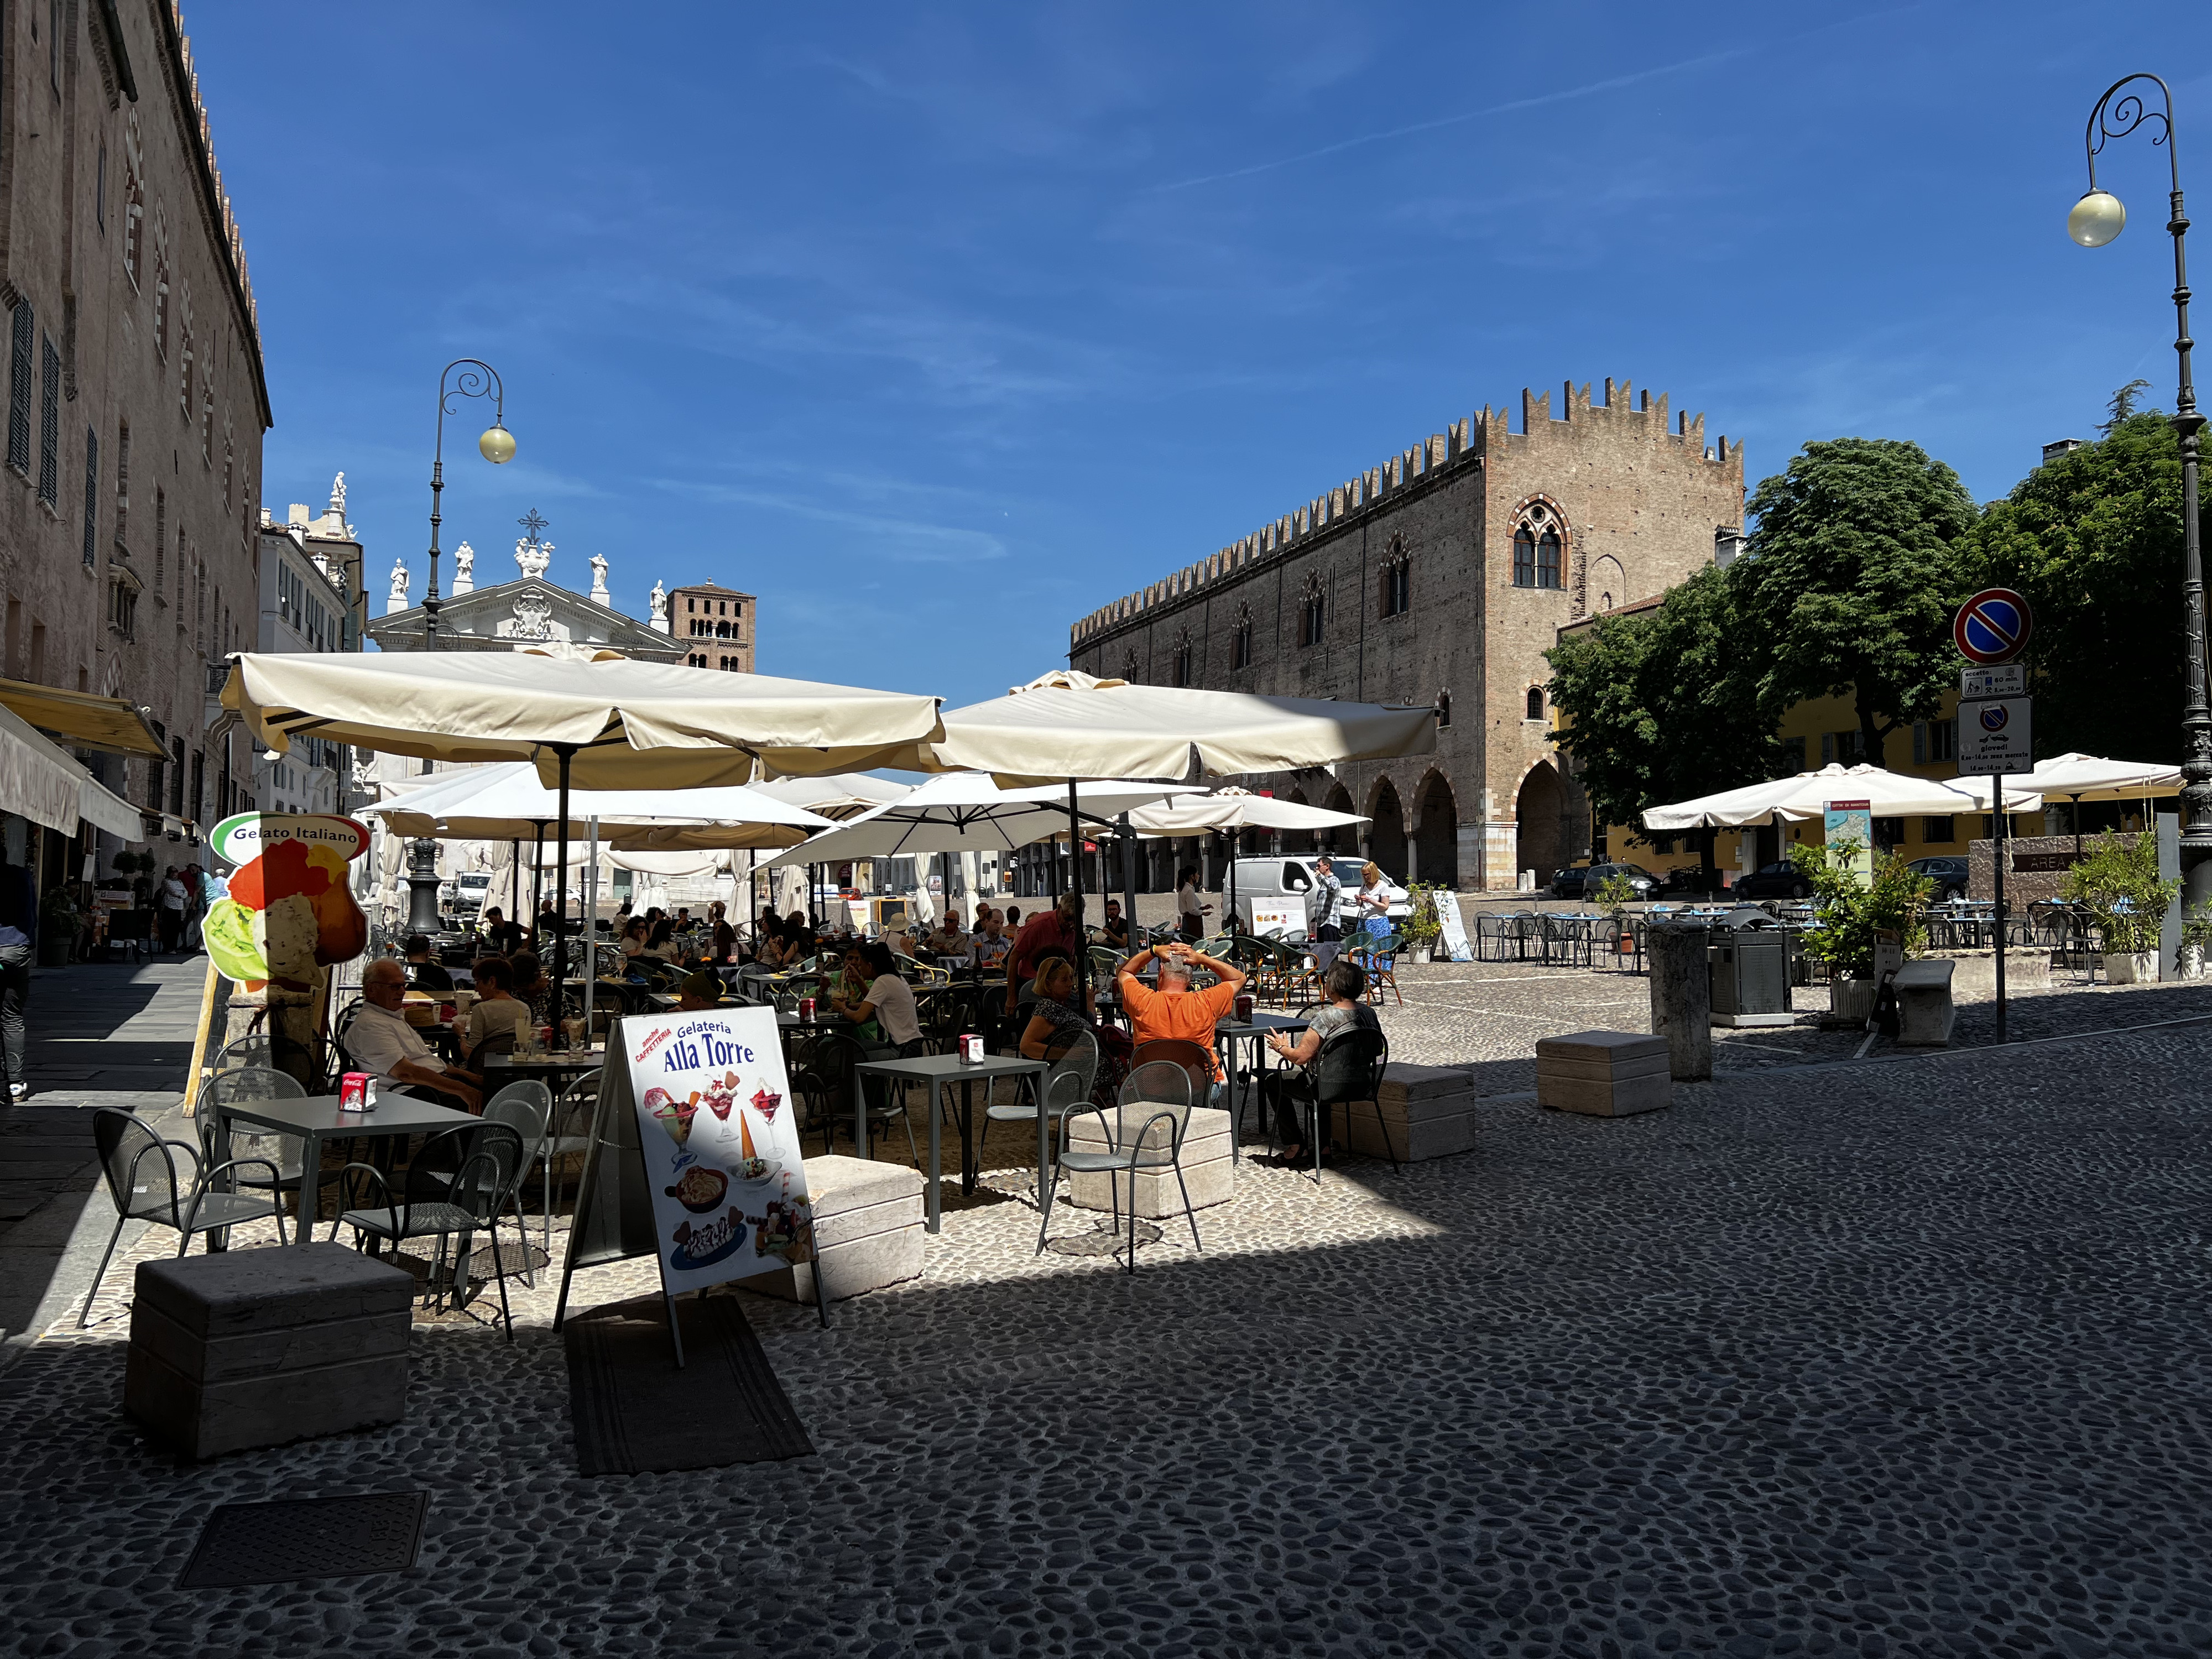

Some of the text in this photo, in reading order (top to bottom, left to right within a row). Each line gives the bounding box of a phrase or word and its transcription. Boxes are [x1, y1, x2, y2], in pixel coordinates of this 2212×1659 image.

[234, 827, 357, 843] Gelato Italiano
[2030, 857, 2066, 869] AREA
[642, 1028, 659, 1047] anche
[677, 1021, 731, 1038] Gelateria
[635, 1028, 671, 1062] CAFFETTERIA
[664, 1034, 754, 1072] Alla Torre
